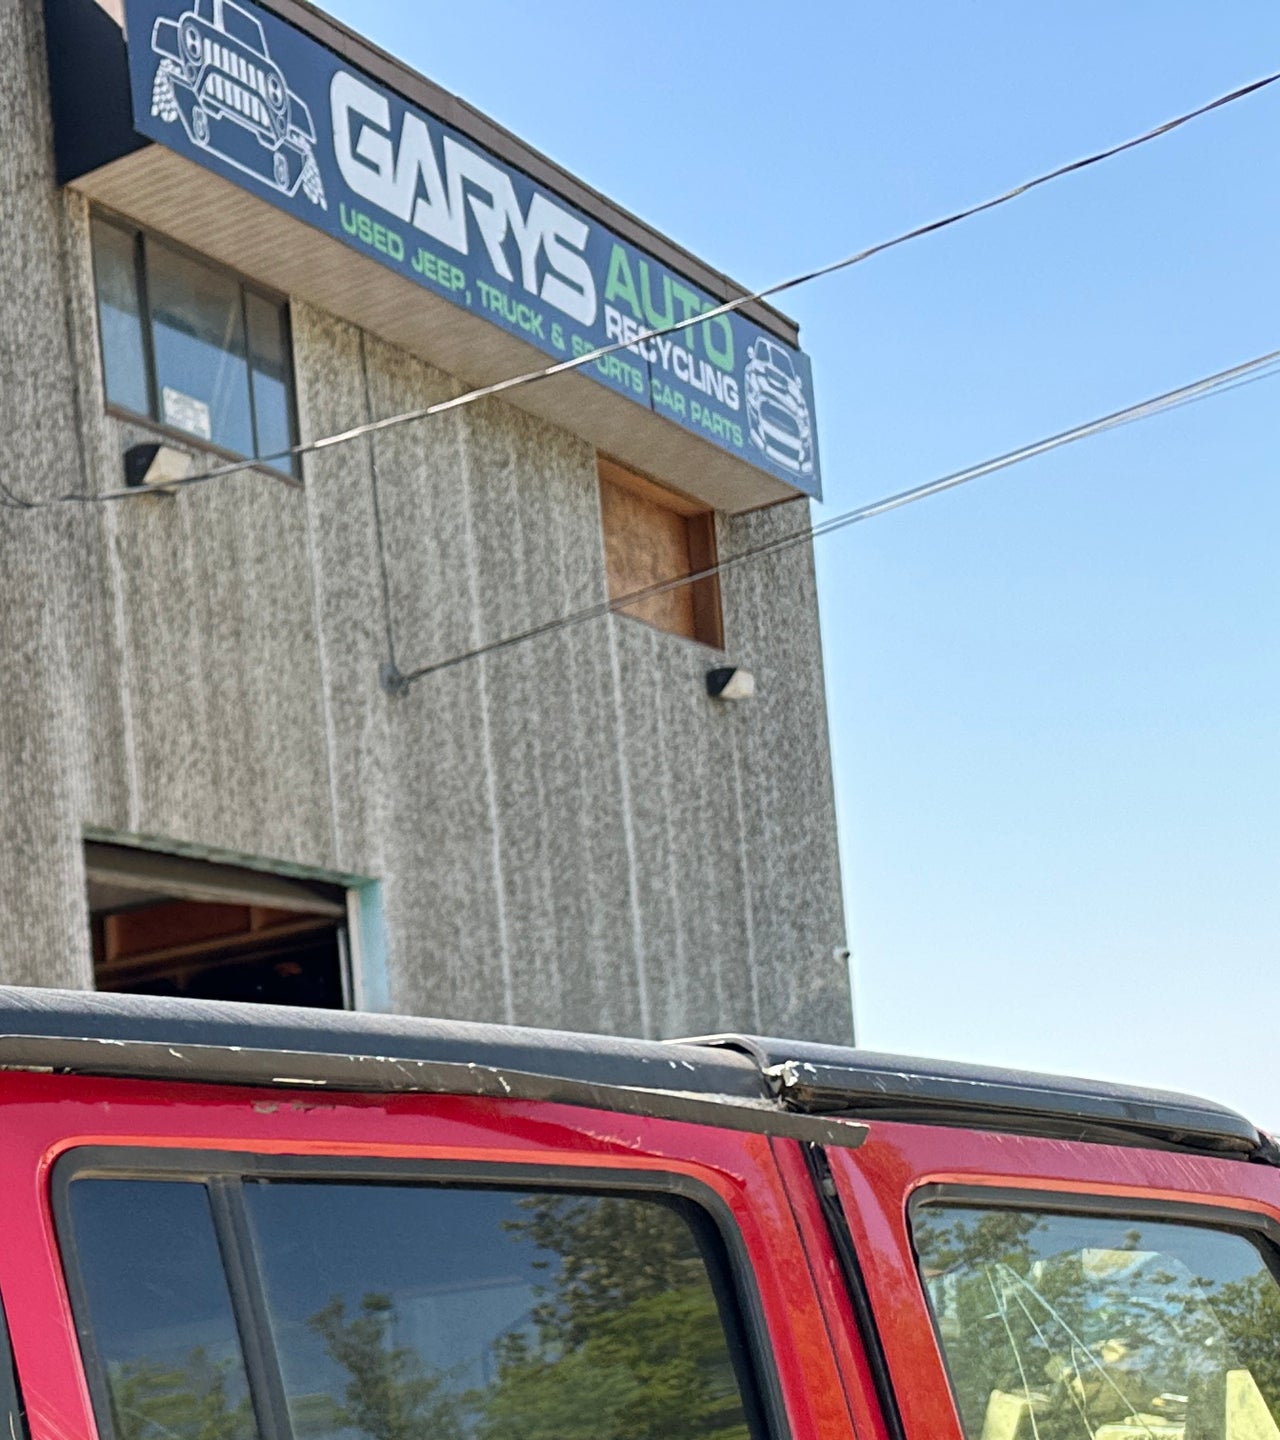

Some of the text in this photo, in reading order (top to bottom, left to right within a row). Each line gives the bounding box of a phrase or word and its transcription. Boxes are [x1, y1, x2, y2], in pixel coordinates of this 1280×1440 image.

[329, 69, 597, 327] GARYS
[339, 203, 744, 448] USED JEEP, TRUCK & SPORTS CAR PARTS
[604, 242, 735, 372] AUTO
[604, 303, 741, 411] RECYCLING
